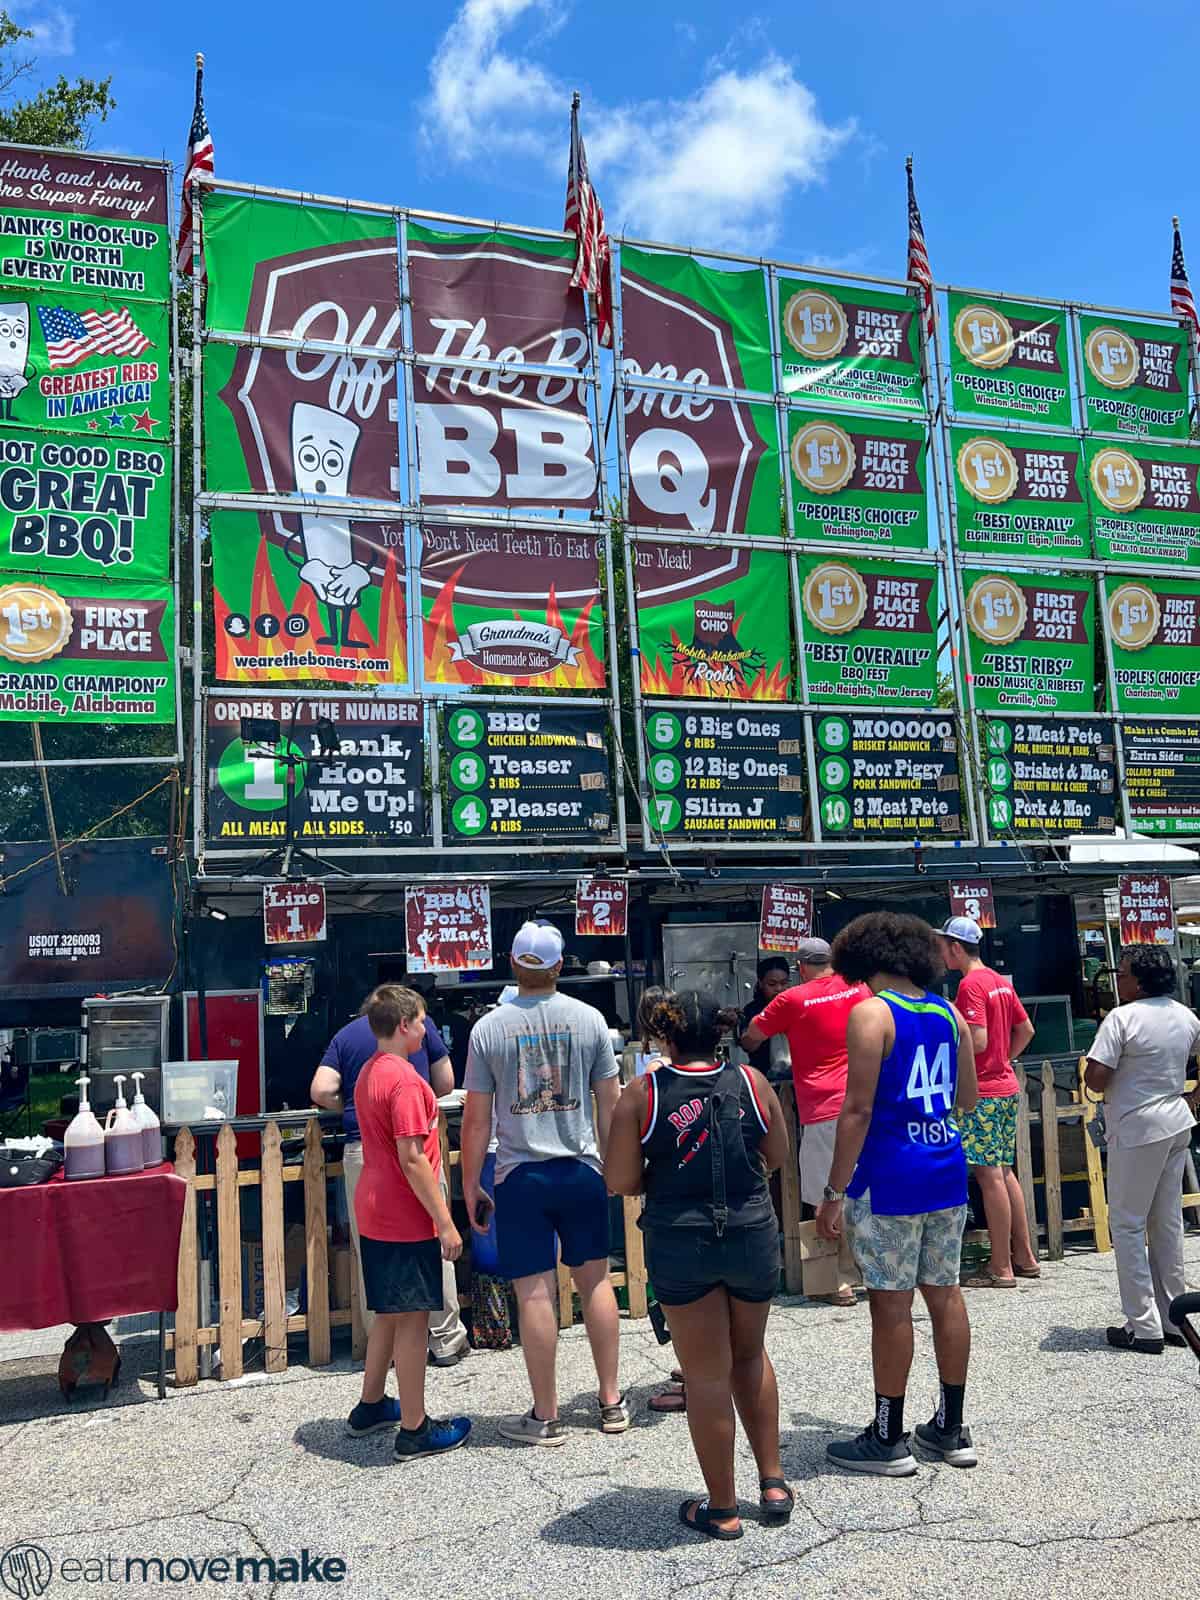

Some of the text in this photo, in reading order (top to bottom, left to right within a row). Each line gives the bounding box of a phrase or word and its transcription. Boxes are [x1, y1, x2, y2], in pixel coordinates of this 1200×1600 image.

[1, 160, 143, 193] Hank and John
[25, 239, 123, 267] IS WORTH
[3, 259, 145, 291] EVERY PENNY!
[799, 305, 834, 345] 1st
[857, 310, 899, 329] FIRST
[854, 325, 902, 343] PLACE
[858, 341, 899, 357] 2021
[1018, 346, 1055, 364] PLACE
[286, 301, 402, 419] Off
[425, 317, 524, 397] The
[40, 362, 159, 396] GREATEST RIBS
[1145, 371, 1169, 388] 2021
[47, 382, 151, 418] IN AMERICA!
[806, 438, 841, 478] 1st
[865, 440, 907, 458] FIRST
[389, 398, 718, 533] BBQ
[862, 455, 909, 475] PLACE
[1024, 452, 1065, 470] FIRST
[864, 472, 904, 490] 2021
[1023, 466, 1069, 484] PLACE
[0, 467, 153, 519] GREAT
[1027, 482, 1067, 499] 2019
[1154, 493, 1189, 508] 2019
[823, 523, 892, 539] Washington, PA
[10, 515, 135, 566] BBQ!
[423, 529, 461, 550] Don't
[465, 528, 498, 553] Need
[502, 532, 542, 556] Teeth
[544, 536, 561, 558] To
[567, 538, 591, 560] Eat
[657, 547, 692, 571] Meat!
[877, 580, 919, 597] FIRST
[818, 578, 854, 618] 1st
[873, 596, 920, 613] PLACE
[2, 602, 52, 646] 1st
[84, 607, 150, 630] FIRST
[700, 619, 728, 633] OHIO
[874, 613, 915, 629] 2021
[479, 626, 550, 645] Grandma's
[1035, 623, 1073, 640] 2021
[1164, 629, 1193, 644] 2021
[80, 629, 153, 653] PLACE
[233, 651, 389, 671] wearetheboners.com
[483, 650, 549, 668] Homemade Sides
[841, 666, 889, 681] BBQ FEST
[0, 692, 156, 715] Mobile, Alabama
[999, 692, 1057, 706] Orrville, Ohio
[214, 702, 419, 721] ORDER BY THE NUMBER
[457, 712, 541, 741] 2 BBC
[655, 716, 781, 743] 5 6 Big Ones
[487, 734, 527, 746] CHICKEN
[529, 734, 577, 746] SANDWICH
[685, 738, 716, 749] 6 RIBS
[990, 725, 1102, 748] 11 2 Meat Pete
[852, 740, 886, 751] BRISKET
[888, 741, 930, 752] SANDWICH
[1130, 750, 1157, 761] Extra
[1159, 751, 1184, 762] Sides
[459, 755, 572, 785] 3 Teaser
[654, 757, 788, 784] 6 12 Big Ones
[825, 762, 844, 785] 9
[853, 759, 892, 777] Poor
[894, 759, 945, 781] Piggy
[991, 762, 1108, 785] 12 Brisket & Mac
[1126, 768, 1152, 776] COLLARD
[489, 778, 520, 789] 3 RIBS
[686, 778, 721, 789] 12 RIBS
[853, 779, 921, 790] PORK SANDWICH
[309, 790, 416, 817] Me Up!
[655, 797, 764, 825] 7 Slim J
[826, 800, 845, 825] 10
[854, 798, 864, 815] 3
[867, 798, 908, 815] Meat
[910, 798, 949, 815] Pete
[993, 799, 1091, 822] 13 Pork & Mac
[461, 798, 582, 828] 4 Pleaser
[491, 821, 522, 832] 4 RIBS
[684, 818, 725, 830] SAUSAGE
[727, 818, 776, 830] SANDWICH
[580, 883, 623, 900] Line
[953, 885, 988, 898] Line
[1131, 880, 1159, 894] Beef
[268, 891, 320, 908] Line
[1122, 896, 1169, 908] Brisket
[424, 911, 473, 926] Pork
[592, 903, 610, 925] 2
[772, 902, 805, 917] Hook
[964, 900, 981, 921] 3
[1127, 909, 1167, 921] & Mac
[287, 907, 304, 933] 1
[767, 915, 808, 931] Me Up!
[29, 934, 100, 947] USDOT 3260093
[29, 948, 40, 957] OFF
[42, 948, 54, 956] THE
[89, 947, 100, 955] LLC
[906, 1042, 953, 1114] 44
